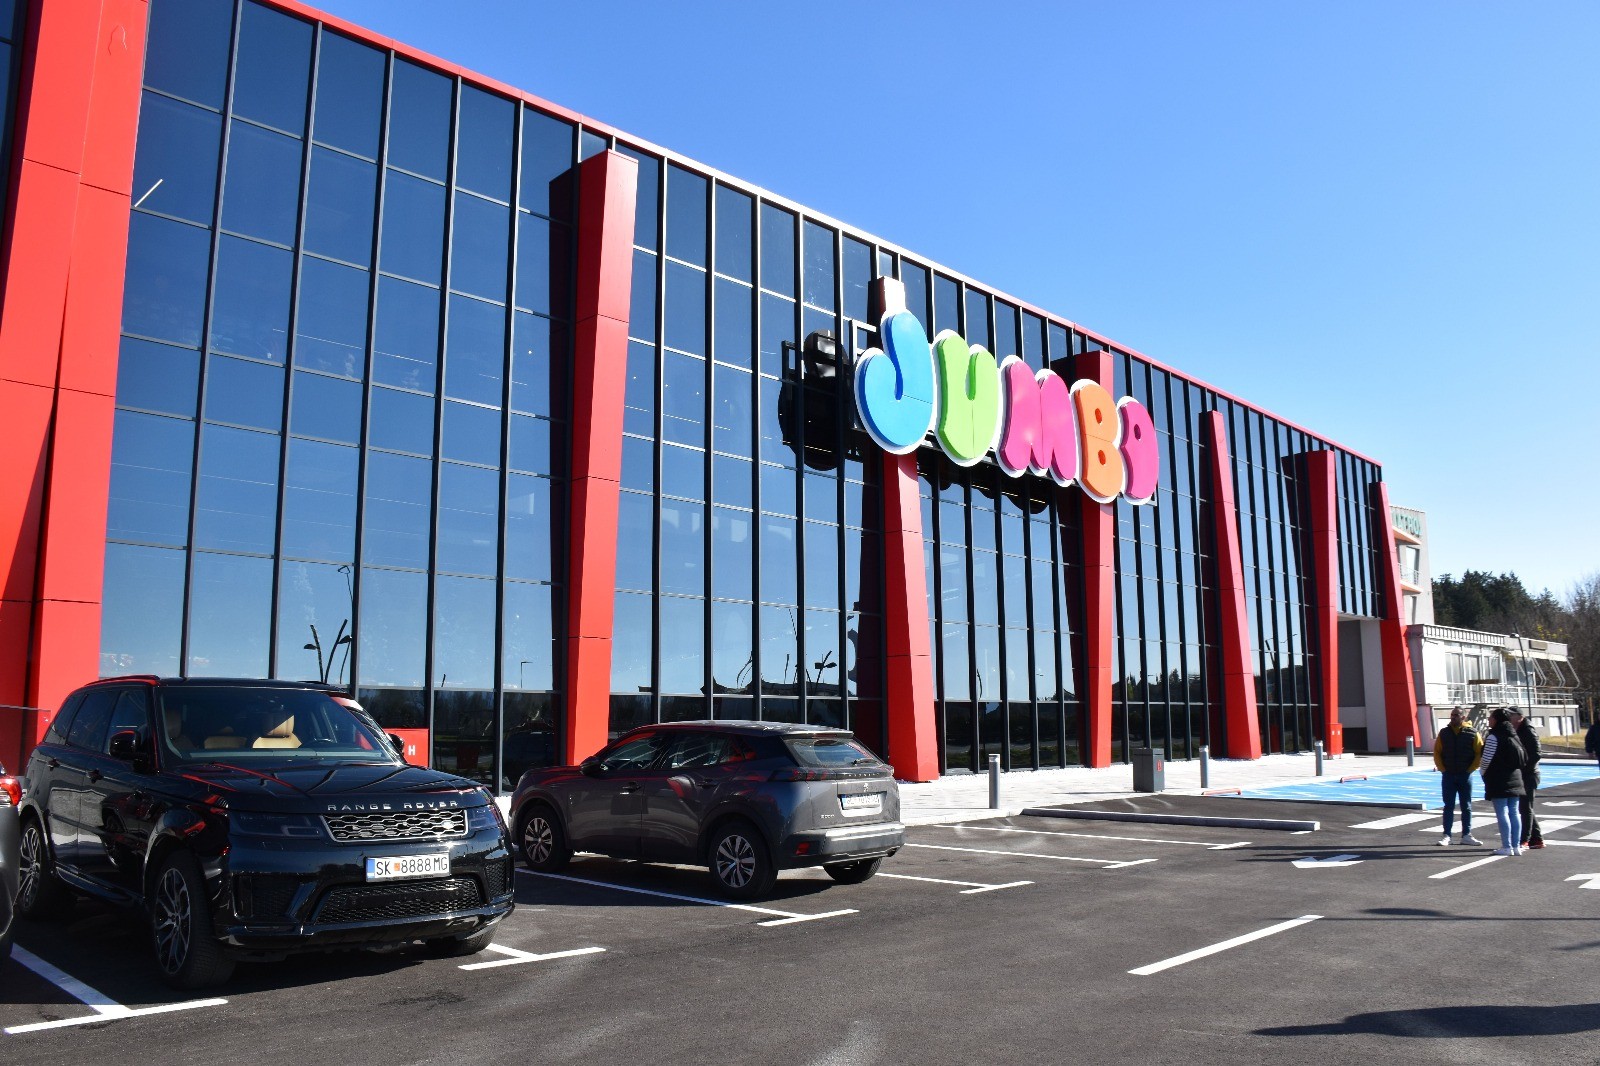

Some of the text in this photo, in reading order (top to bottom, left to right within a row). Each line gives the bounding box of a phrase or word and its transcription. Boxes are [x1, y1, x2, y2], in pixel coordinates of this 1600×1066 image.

[855, 309, 1160, 506] JUMBO
[408, 744, 416, 756] H
[327, 800, 458, 811] RANGE ROVER
[376, 856, 448, 876] SK 8888 MG
